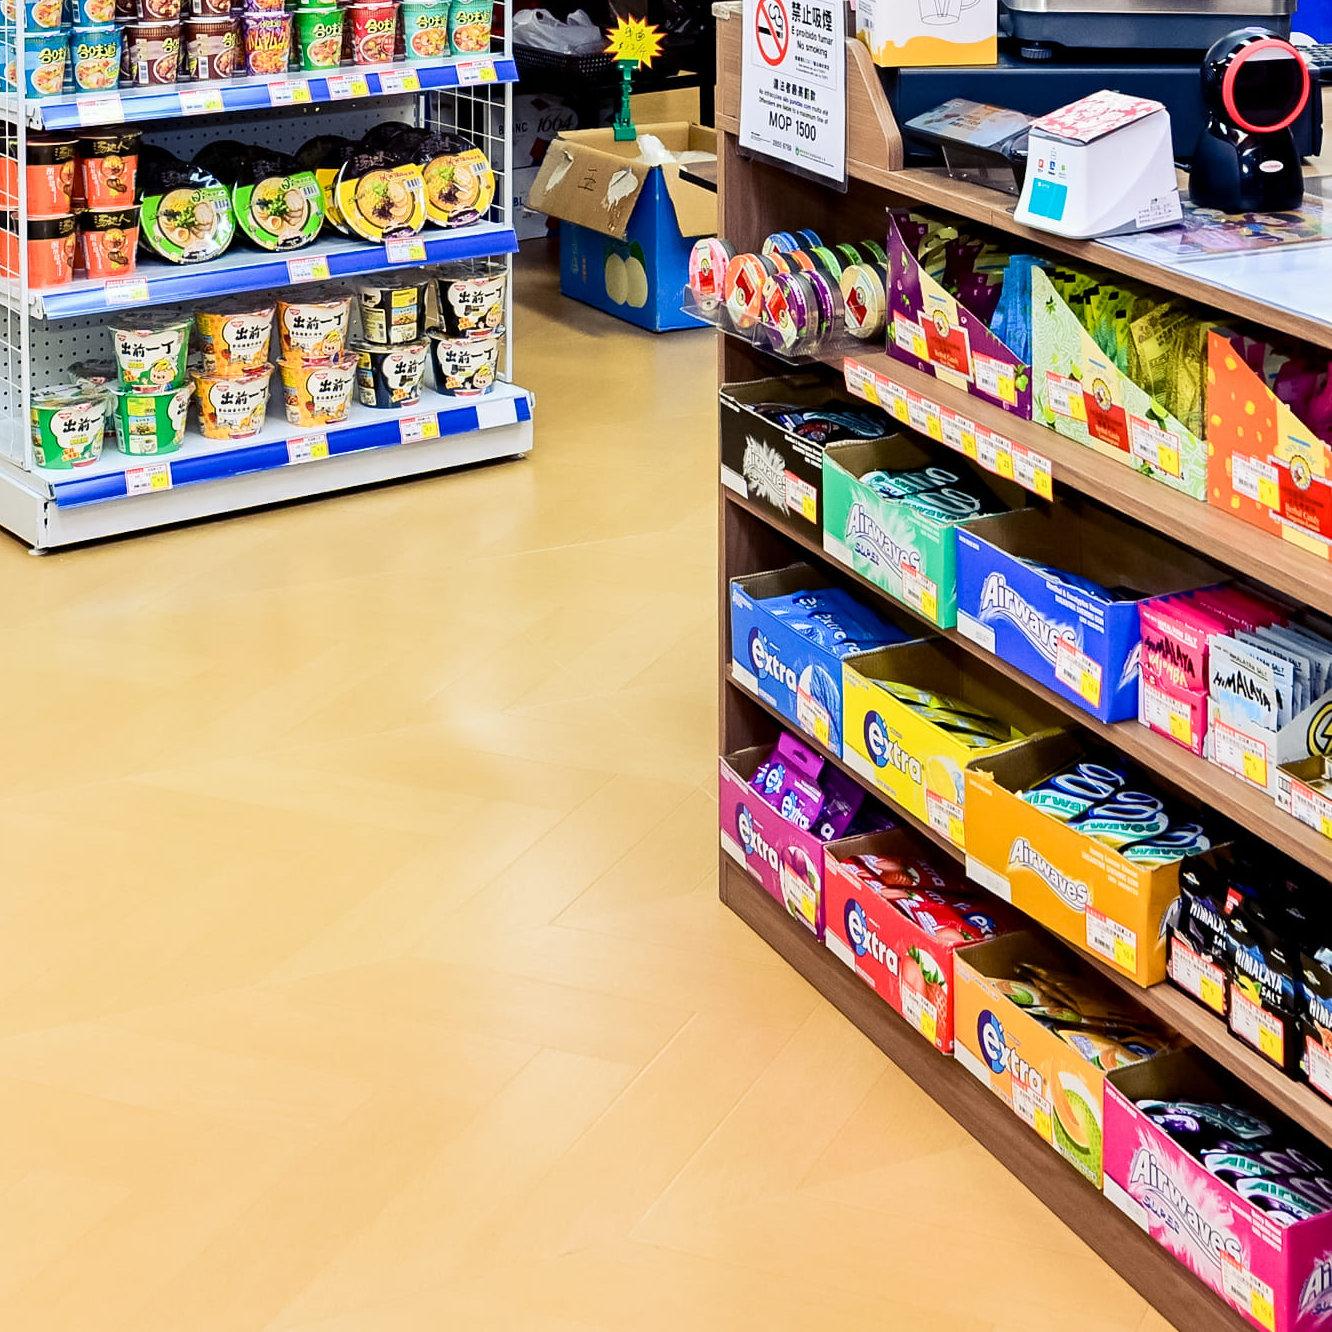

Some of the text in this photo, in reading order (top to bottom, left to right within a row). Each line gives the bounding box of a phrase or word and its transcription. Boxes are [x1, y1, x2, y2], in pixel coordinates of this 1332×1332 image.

[456, 11, 490, 25] 合味道
[791, 1, 833, 32] 禁止吸煙
[77, 43, 118, 58] 合味道
[797, 40, 827, 58] No smoking
[769, 111, 816, 141] MOP 1500
[458, 289, 503, 304] 出前一丁
[293, 312, 343, 330] 出前一丁
[121, 340, 174, 358] 出前一丁
[445, 348, 494, 364] 出前一丁
[220, 387, 268, 405] 出前一丁
[848, 502, 921, 568] Airwaves
[854, 542, 879, 566] SUPER
[981, 575, 1076, 649] Airwaves
[750, 633, 798, 693] extra
[1213, 670, 1271, 711] HIMALAYA
[868, 720, 923, 785] extra
[738, 811, 780, 872] extra
[1010, 838, 1088, 904] Airwaves
[847, 907, 899, 977] extra
[1235, 947, 1283, 994] HIMALAYA
[1260, 987, 1283, 1004] SALT
[981, 1026, 1044, 1093] extra
[1132, 1148, 1243, 1266] Airwaves
